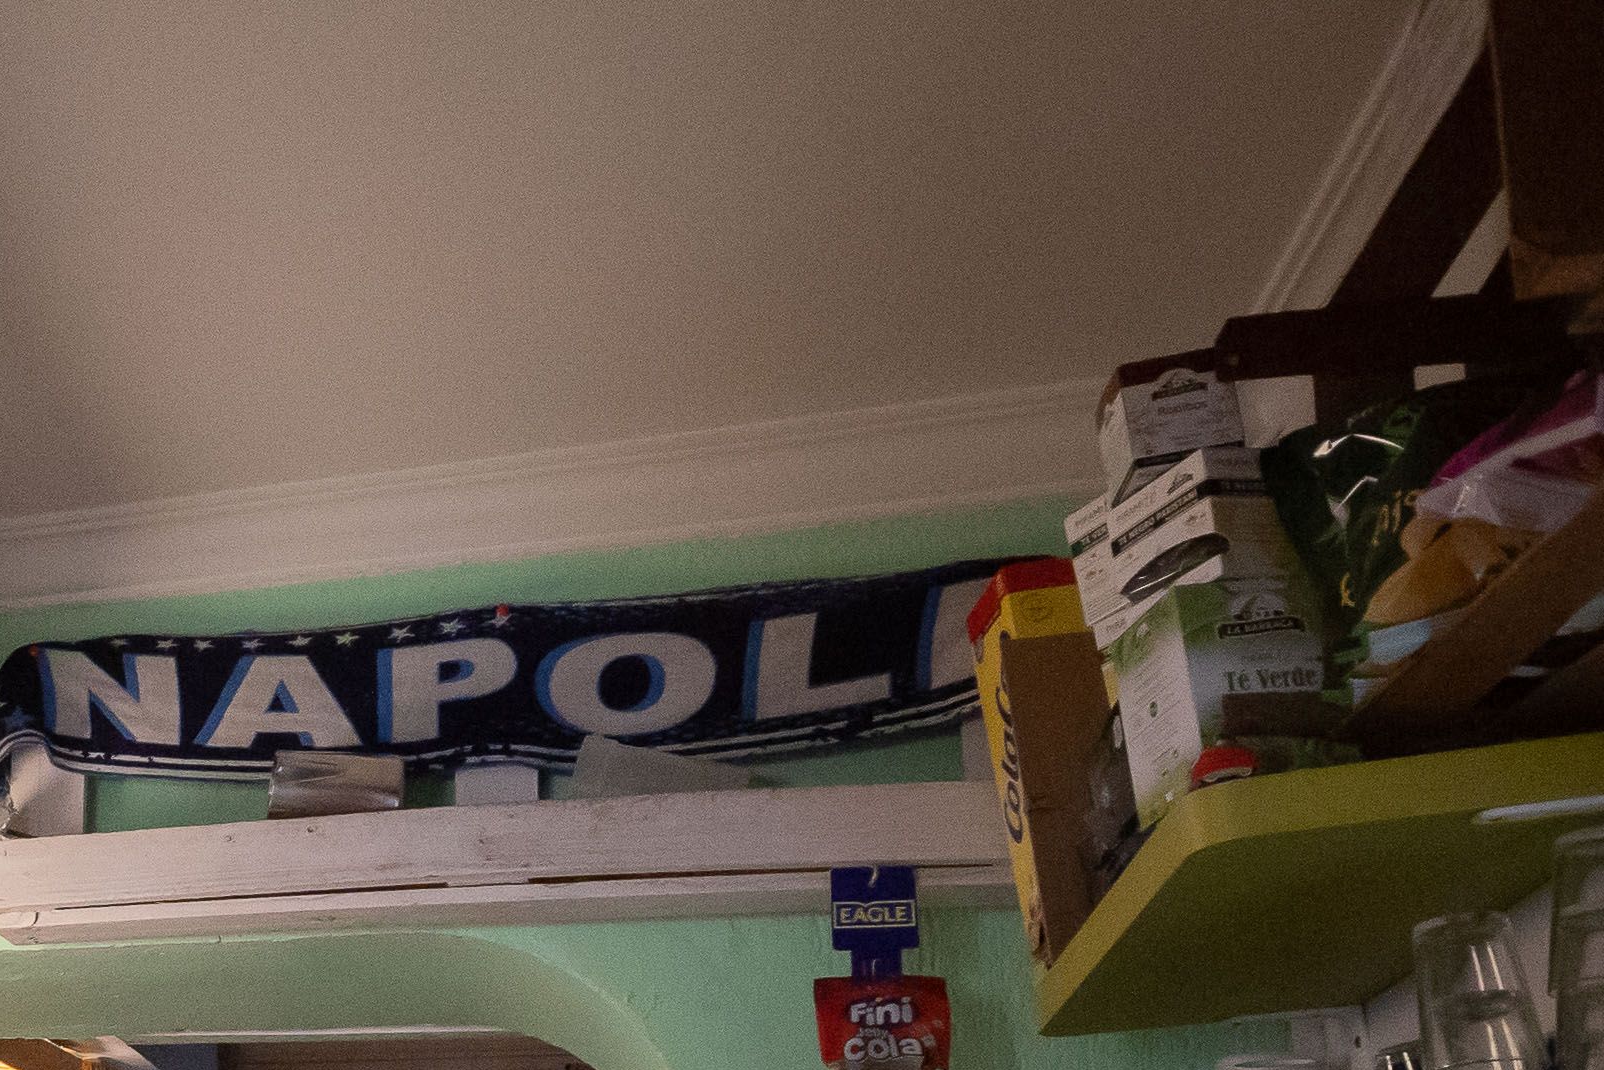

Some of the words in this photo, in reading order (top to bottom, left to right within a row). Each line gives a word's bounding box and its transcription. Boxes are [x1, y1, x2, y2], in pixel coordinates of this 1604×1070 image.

[36, 578, 990, 748] NAPOLI
[1224, 670, 1250, 690] Té
[1256, 666, 1318, 688] Verde
[996, 630, 1022, 844] ColaC
[839, 905, 908, 924] EAGLE
[850, 997, 913, 1026] Fini
